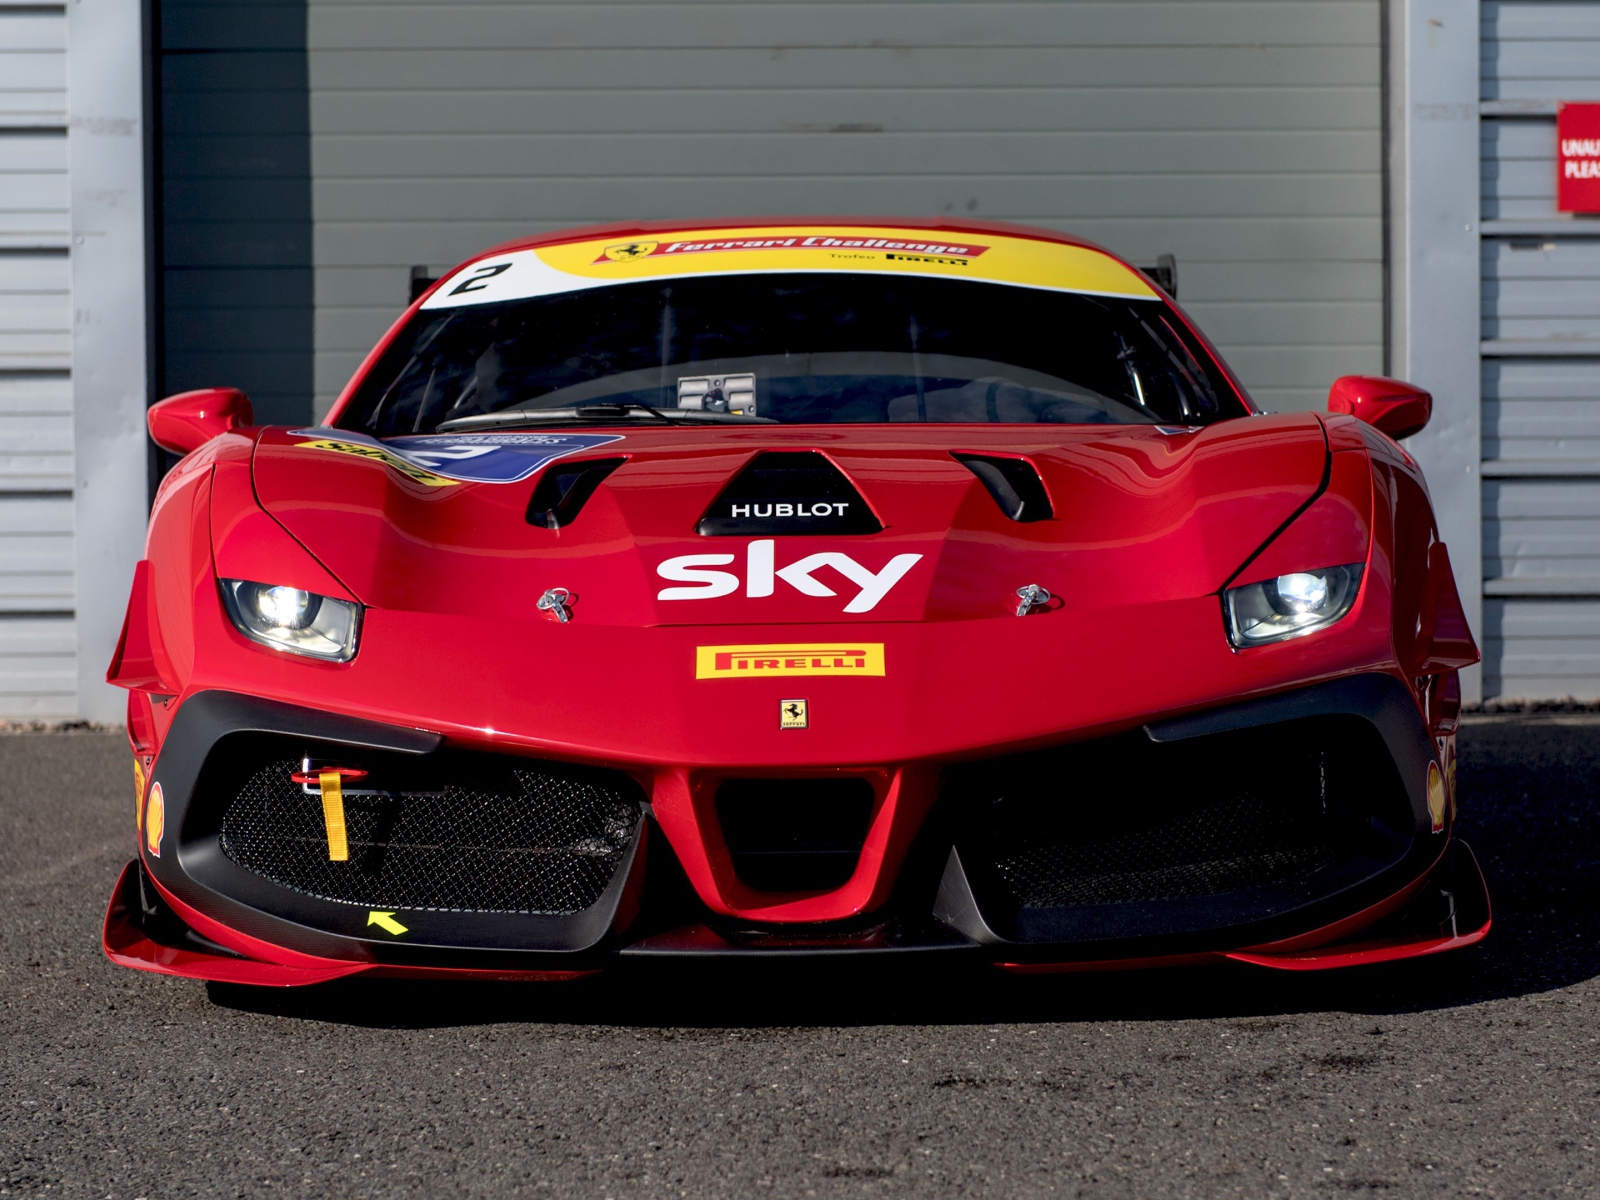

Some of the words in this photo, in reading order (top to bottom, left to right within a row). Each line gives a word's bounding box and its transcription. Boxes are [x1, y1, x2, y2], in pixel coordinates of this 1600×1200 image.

[665, 238, 798, 253] Ferrari
[801, 236, 969, 254] Challenge
[886, 253, 968, 266] PIRELLI
[446, 262, 513, 297] 2
[731, 502, 849, 518] HUBLOT
[656, 539, 924, 614] sky
[714, 649, 867, 671] PIRELLI
